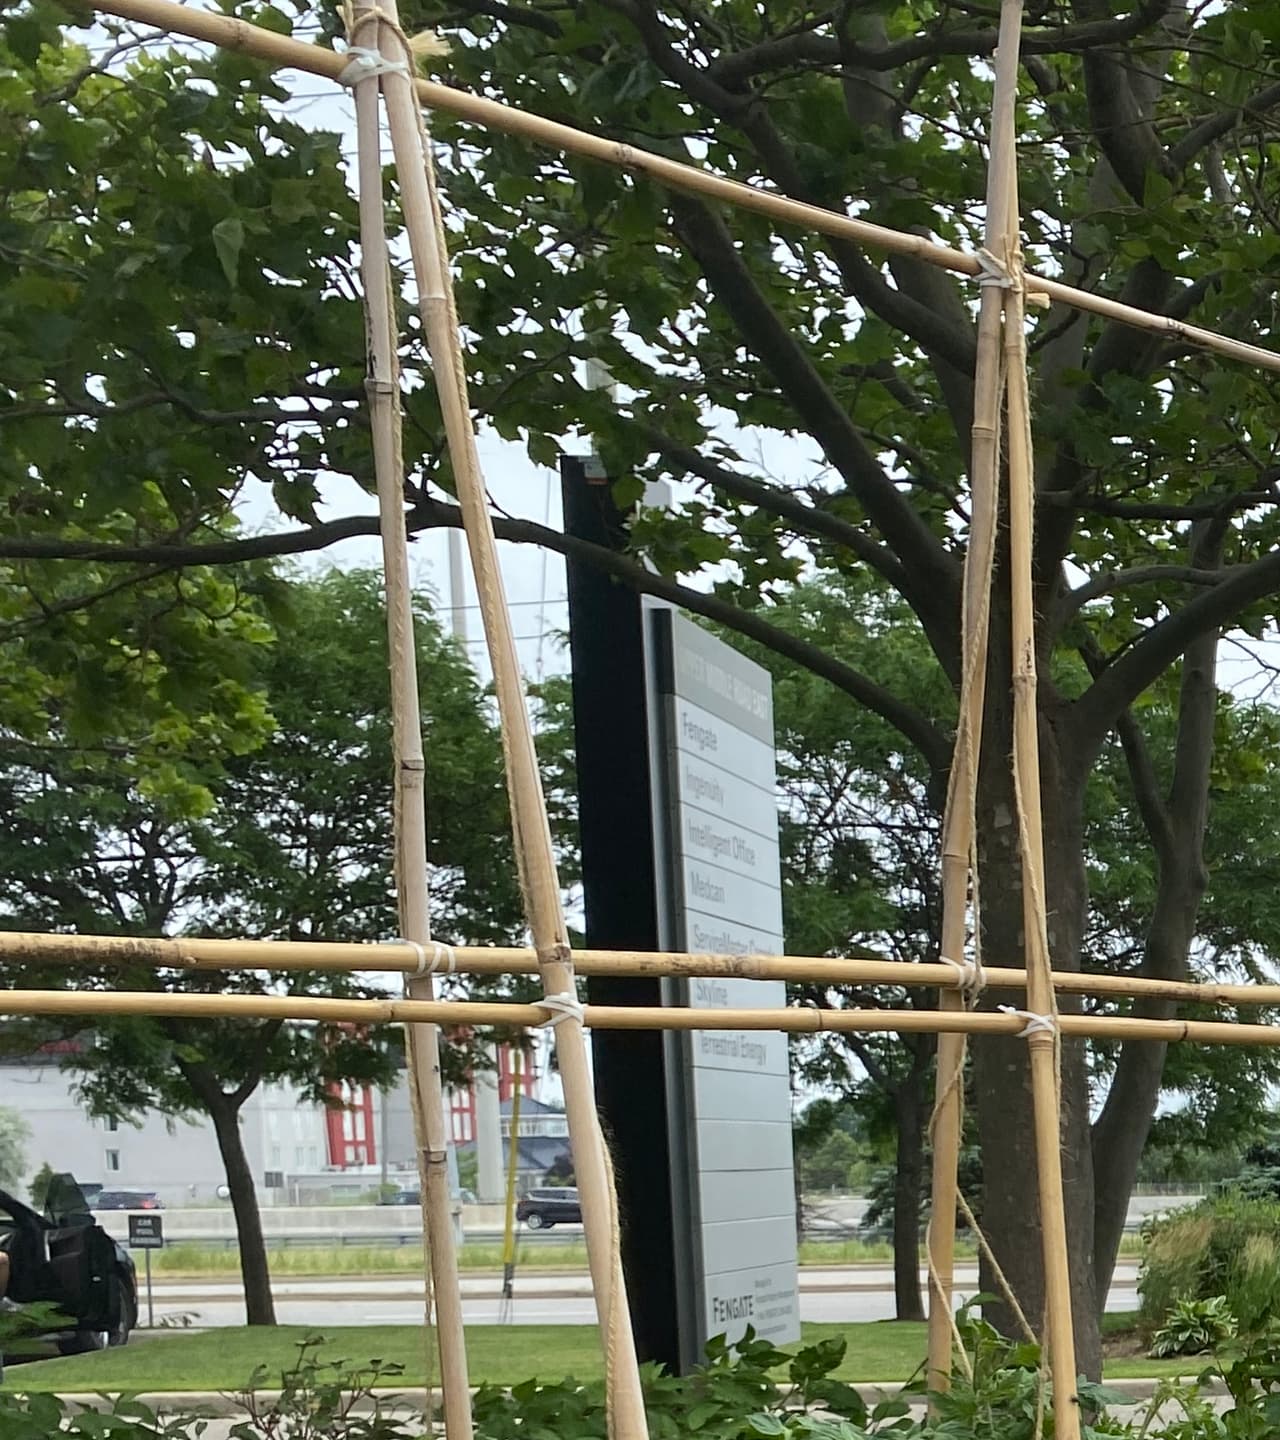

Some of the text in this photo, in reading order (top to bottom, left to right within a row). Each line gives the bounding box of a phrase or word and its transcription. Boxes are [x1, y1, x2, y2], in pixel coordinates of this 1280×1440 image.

[752, 689, 769, 721] EAST
[682, 711, 718, 752] Fengate
[685, 764, 724, 808] Ingenuity
[688, 818, 756, 866] Intelligent Office
[690, 871, 726, 904] Medcan
[696, 979, 728, 1009] Skyline
[699, 1029, 768, 1066] Terrestrial Energy
[712, 1295, 754, 1324] FENGATE
